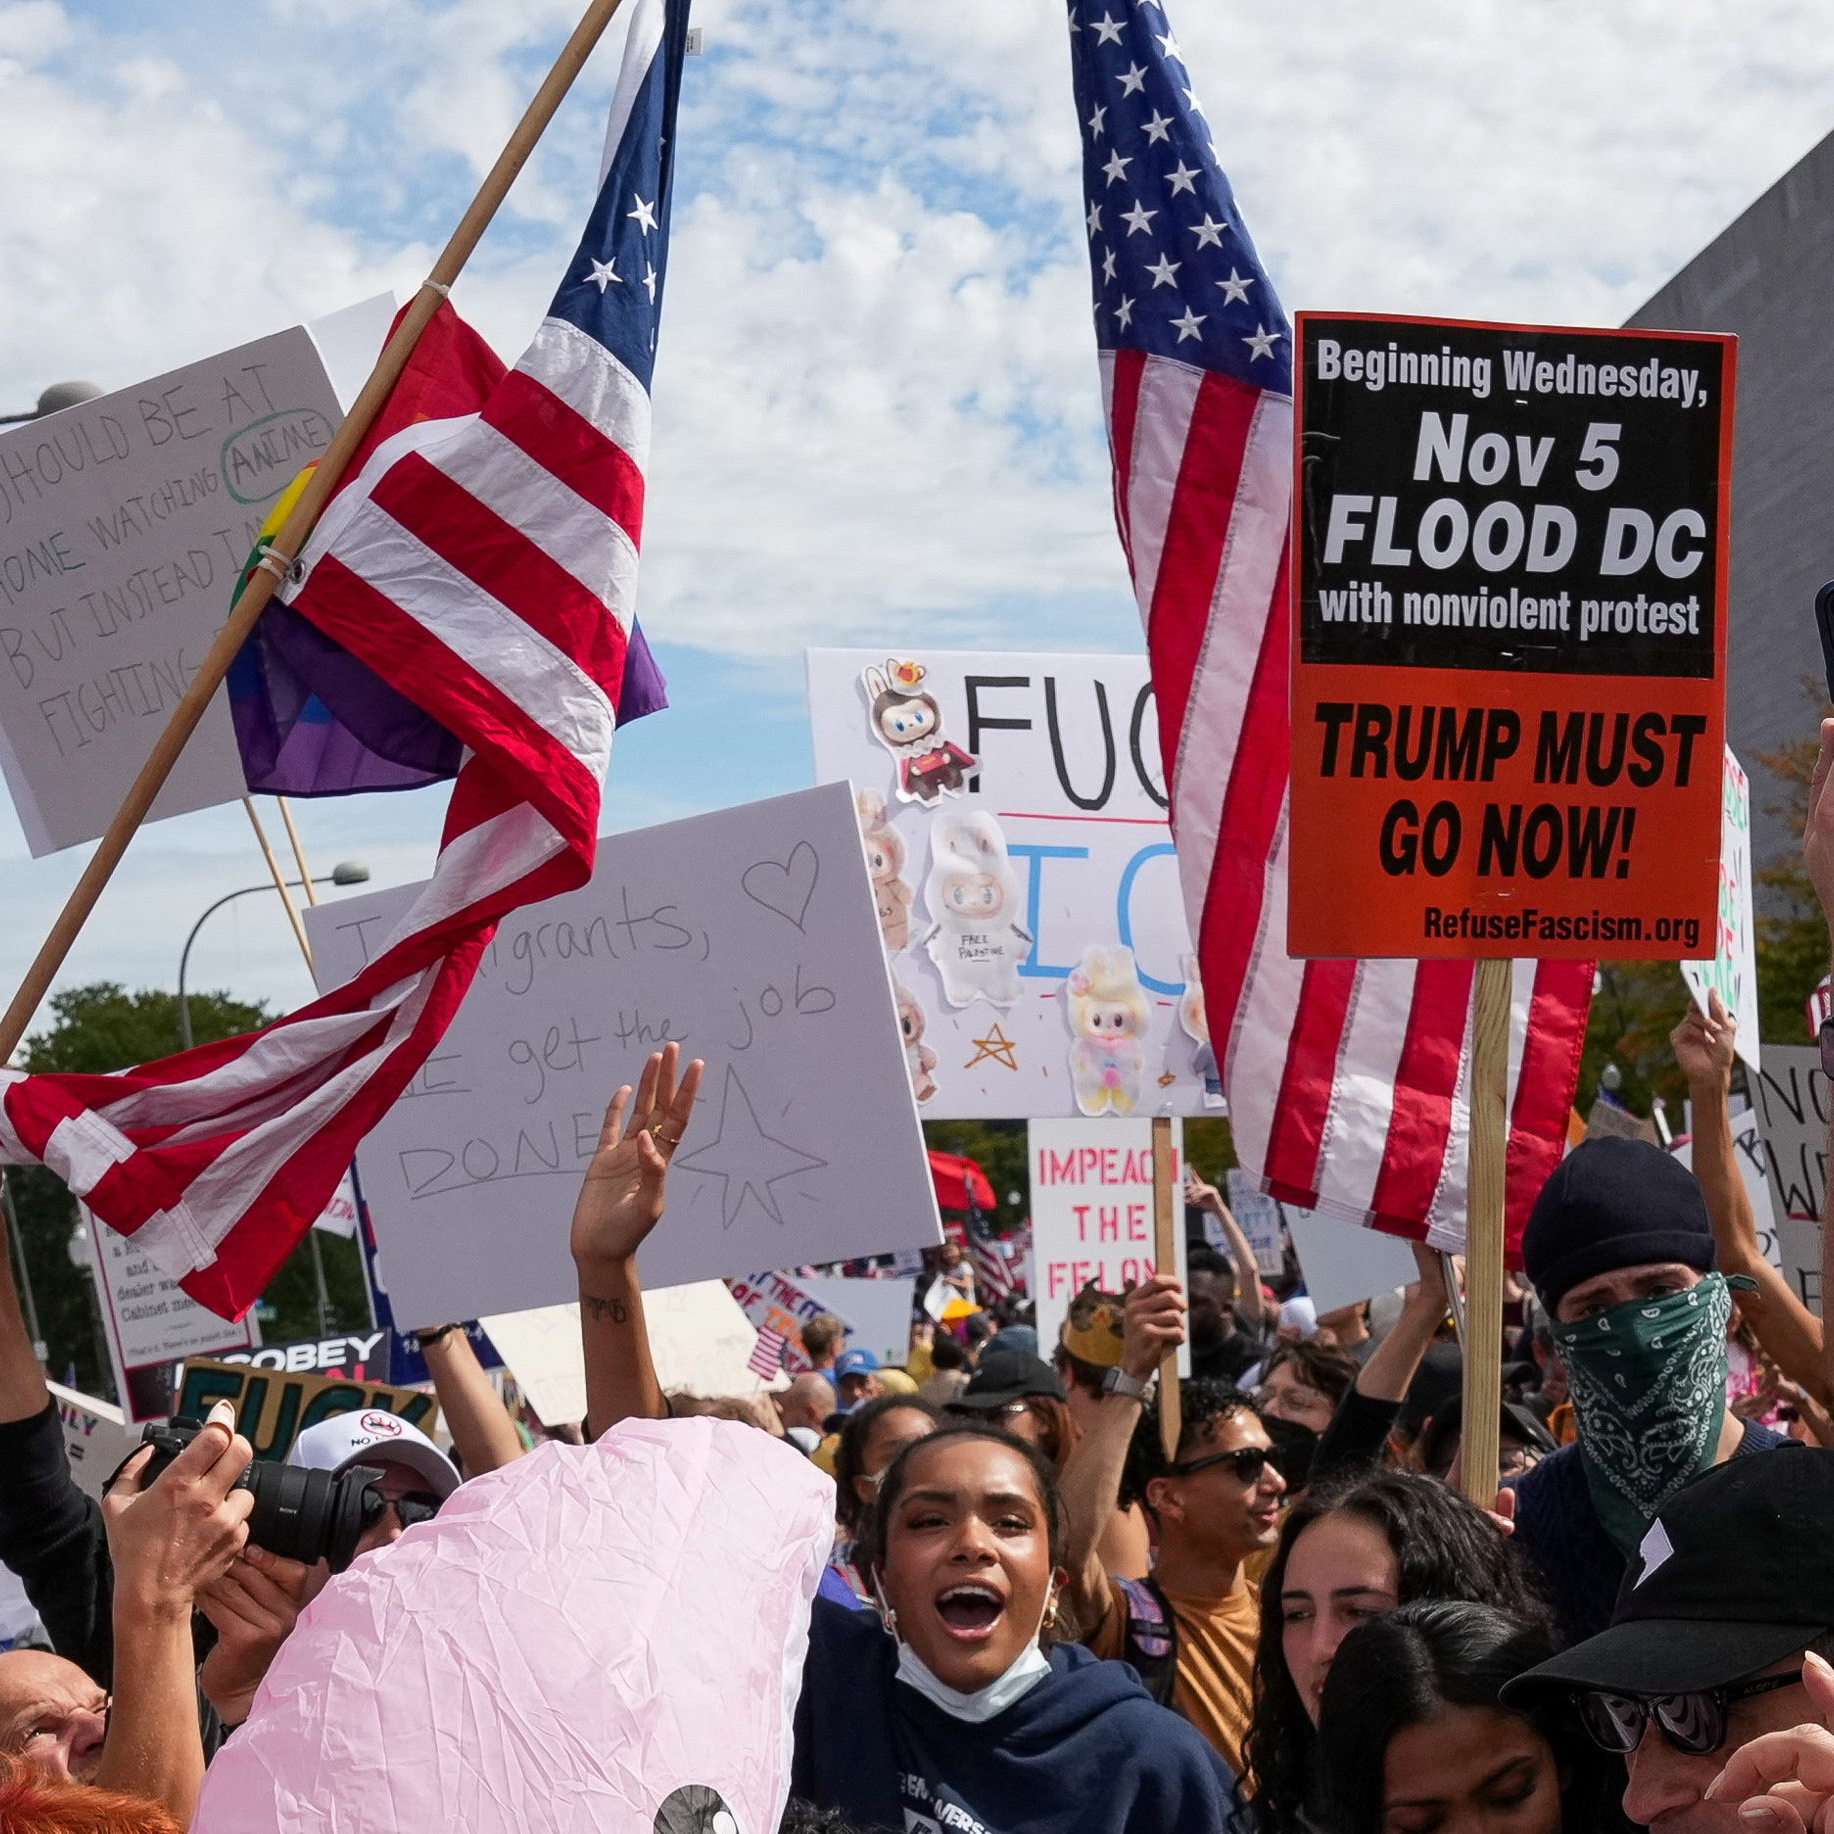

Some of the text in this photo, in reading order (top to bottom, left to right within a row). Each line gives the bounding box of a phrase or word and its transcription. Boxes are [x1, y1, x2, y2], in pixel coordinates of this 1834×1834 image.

[140, 384, 212, 448] BE
[221, 362, 281, 424] AT
[1316, 339, 1709, 409] Beginning Wednesday,
[88, 464, 219, 551] WATCHING
[230, 422, 330, 488] ANIME
[1413, 411, 1622, 491] Nov 5
[1323, 494, 1708, 579] FLOOD DC
[78, 549, 216, 640] INSTEAD
[1319, 581, 1700, 641] with nonviolent protest
[35, 647, 200, 756] FIGHTING
[964, 675, 1171, 811] FUC
[1314, 701, 1708, 788] TRUMP MUST
[1379, 798, 1638, 879] GO NOW!
[1007, 843, 1186, 994] IC
[1424, 907, 1701, 948] RefuseFascism.org
[507, 1017, 601, 1104] get
[615, 1009, 689, 1049] the
[728, 964, 837, 1050] job
[399, 1113, 598, 1194] DONE
[1072, 1203, 1148, 1243] THE
